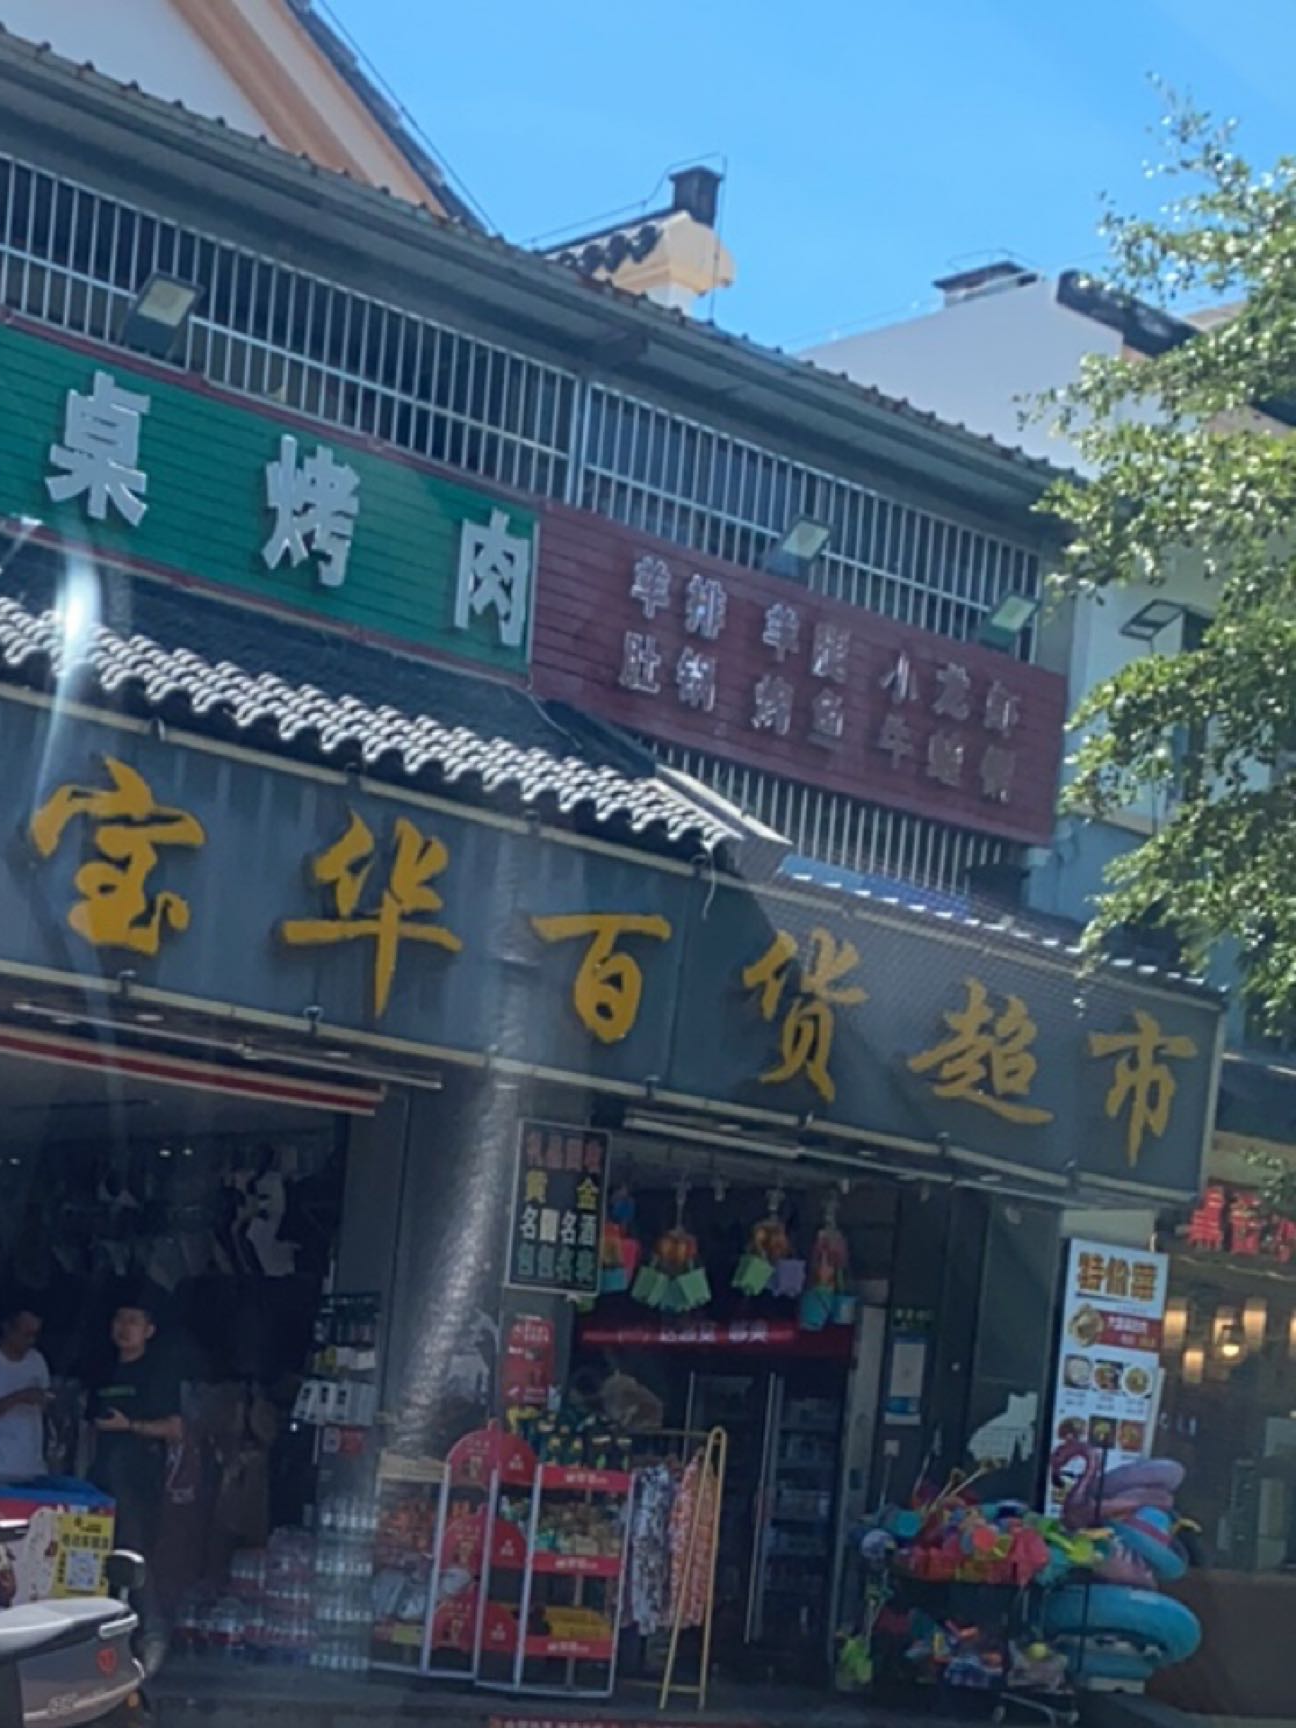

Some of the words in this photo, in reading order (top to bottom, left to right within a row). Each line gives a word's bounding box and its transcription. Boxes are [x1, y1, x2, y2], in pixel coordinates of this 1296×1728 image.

[30, 758, 1199, 1168] 宝华百货超市
